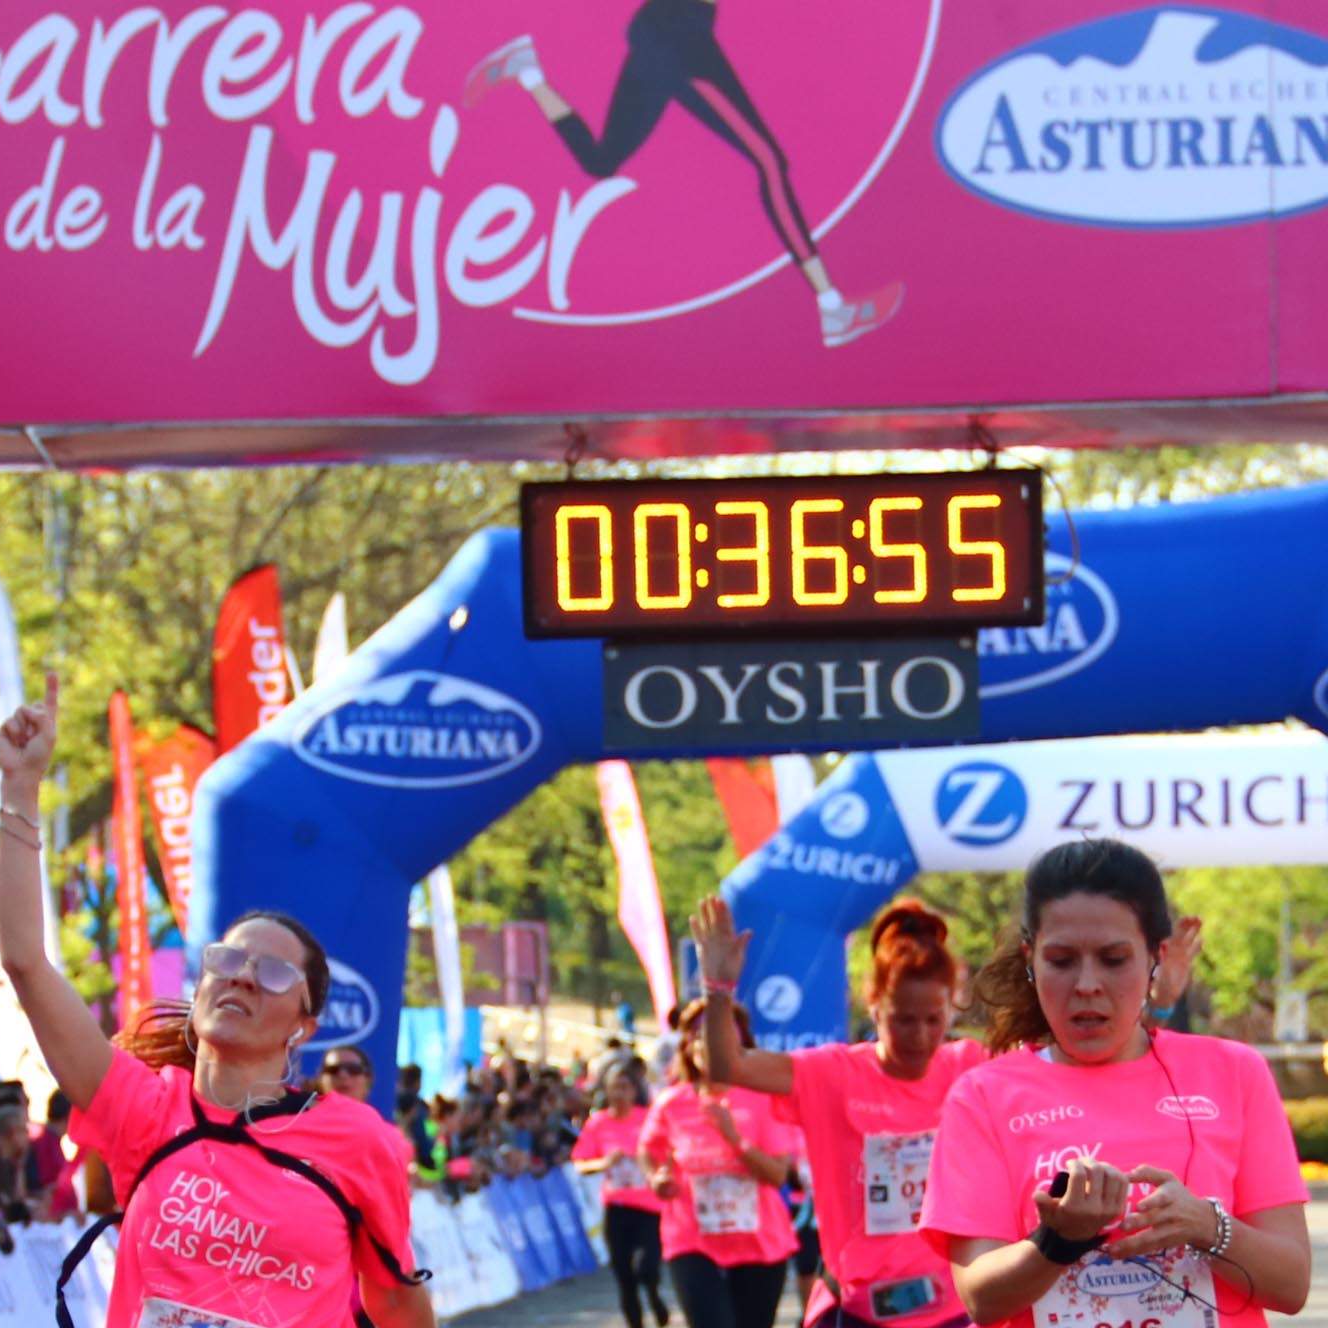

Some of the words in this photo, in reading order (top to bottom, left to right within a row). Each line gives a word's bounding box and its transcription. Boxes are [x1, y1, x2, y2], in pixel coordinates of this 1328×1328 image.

[3, 136, 108, 252] de
[131, 132, 206, 252] la
[192, 105, 639, 386] Mujer
[555, 493, 1006, 612] 00:36:55
[624, 656, 966, 729] OYSHO
[308, 710, 522, 761] ASTURIANA
[1009, 1104, 1085, 1134] OYSHO
[169, 1170, 231, 1208] HOY
[160, 1196, 268, 1249] GANAN
[149, 1222, 201, 1259] LAS
[205, 1242, 316, 1291] CHICAS
